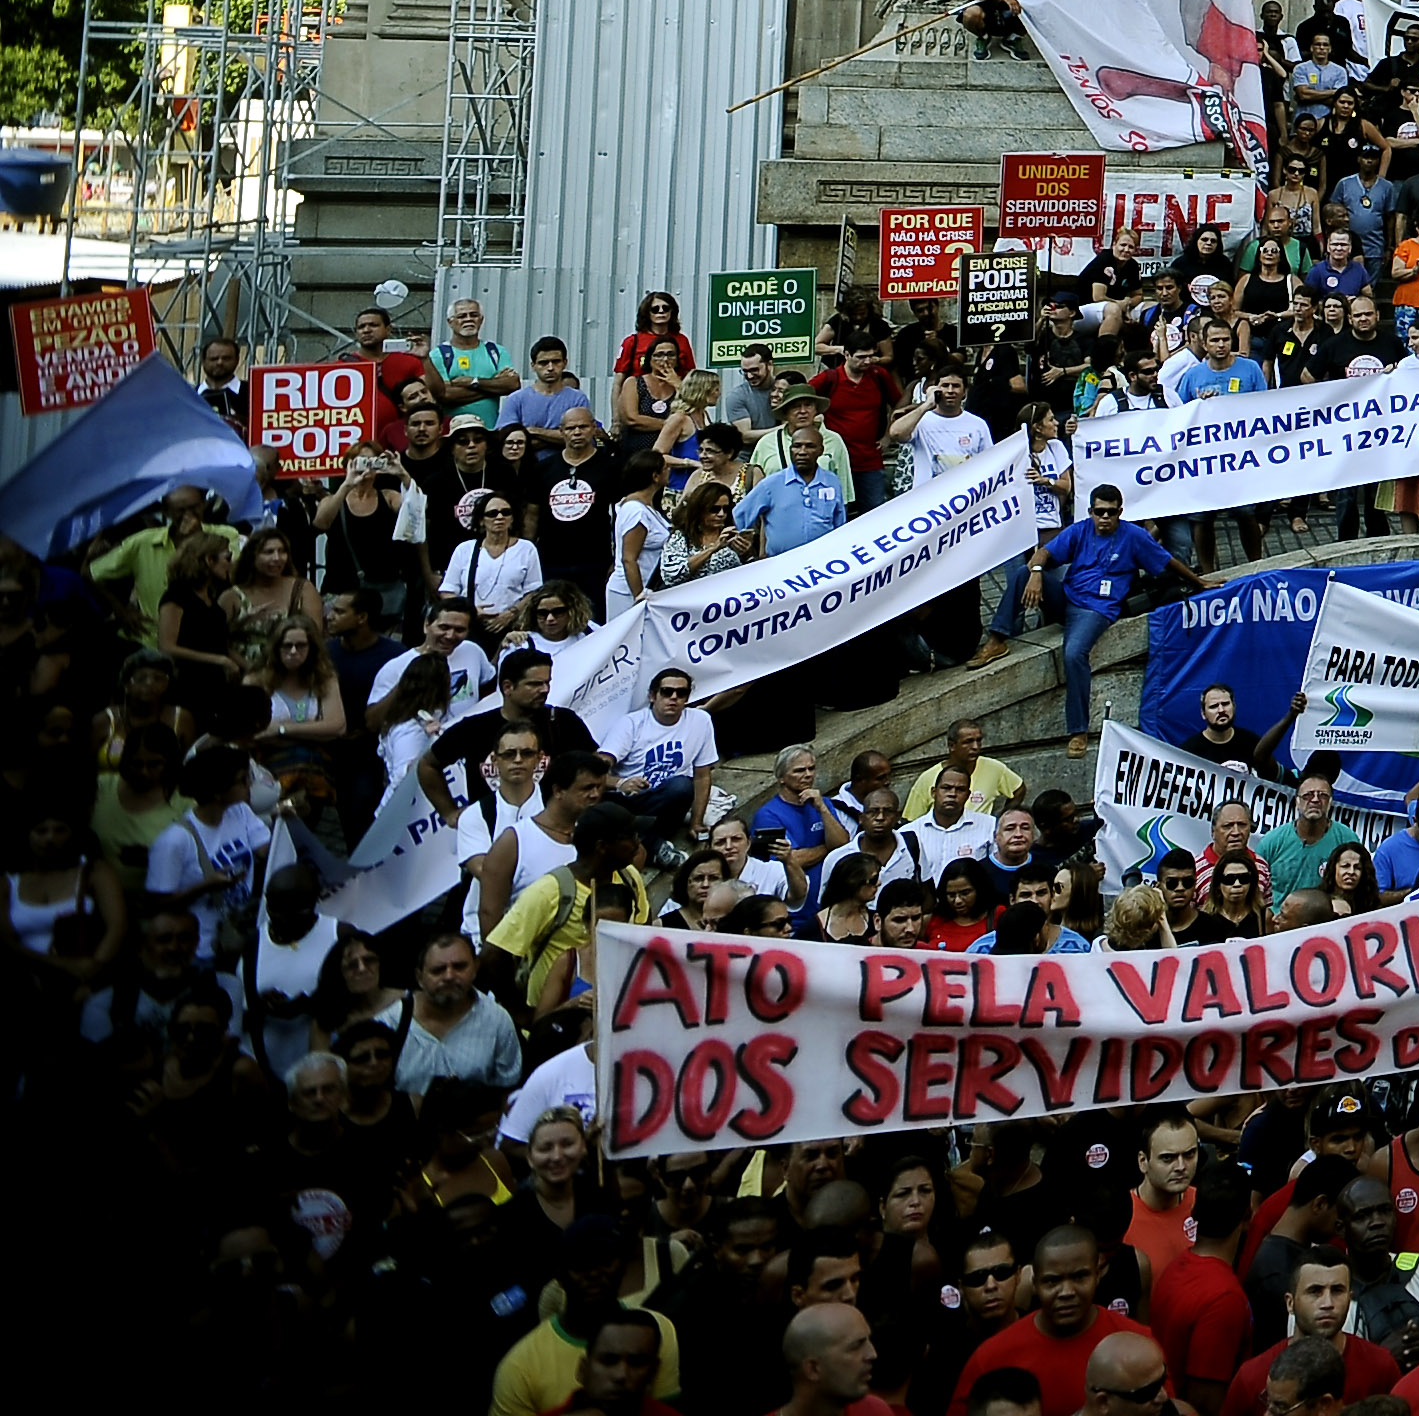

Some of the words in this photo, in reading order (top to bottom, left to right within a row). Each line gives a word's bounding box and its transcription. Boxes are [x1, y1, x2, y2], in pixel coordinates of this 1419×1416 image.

[1018, 165, 1090, 179] UNIDADE
[1036, 182, 1070, 197] DOS
[1006, 200, 1097, 213] SERVIDORES
[1006, 216, 1014, 227] E
[1018, 213, 1096, 229] POPULAÇÃO
[727, 277, 778, 297] CADÊ
[784, 279, 798, 295] O
[719, 298, 805, 317] DINHEIRO
[742, 319, 781, 336] DOS
[262, 368, 364, 411] RIO
[262, 408, 365, 428] RESPIRA
[1085, 434, 1168, 460] PELA
[1170, 397, 1384, 451] PERMANÊNCIA
[262, 426, 362, 458] POR
[1134, 450, 1260, 487] CONTRA
[1267, 444, 1290, 465] O
[1299, 438, 1332, 461] PL
[670, 584, 787, 635] 0,003%
[783, 557, 851, 595] NÃO
[856, 542, 871, 567] É
[874, 463, 1015, 554] ECONOMIA!
[686, 604, 813, 666] CONTRA
[820, 589, 844, 614] O
[849, 569, 894, 604] FIM
[898, 549, 932, 578] DA
[936, 495, 1022, 556] FIPERJ!
[612, 936, 807, 1033] ATO
[859, 952, 1082, 1028] PELA
[609, 1032, 799, 1154] DOS
[841, 1007, 1385, 1128] SERVIDORES
